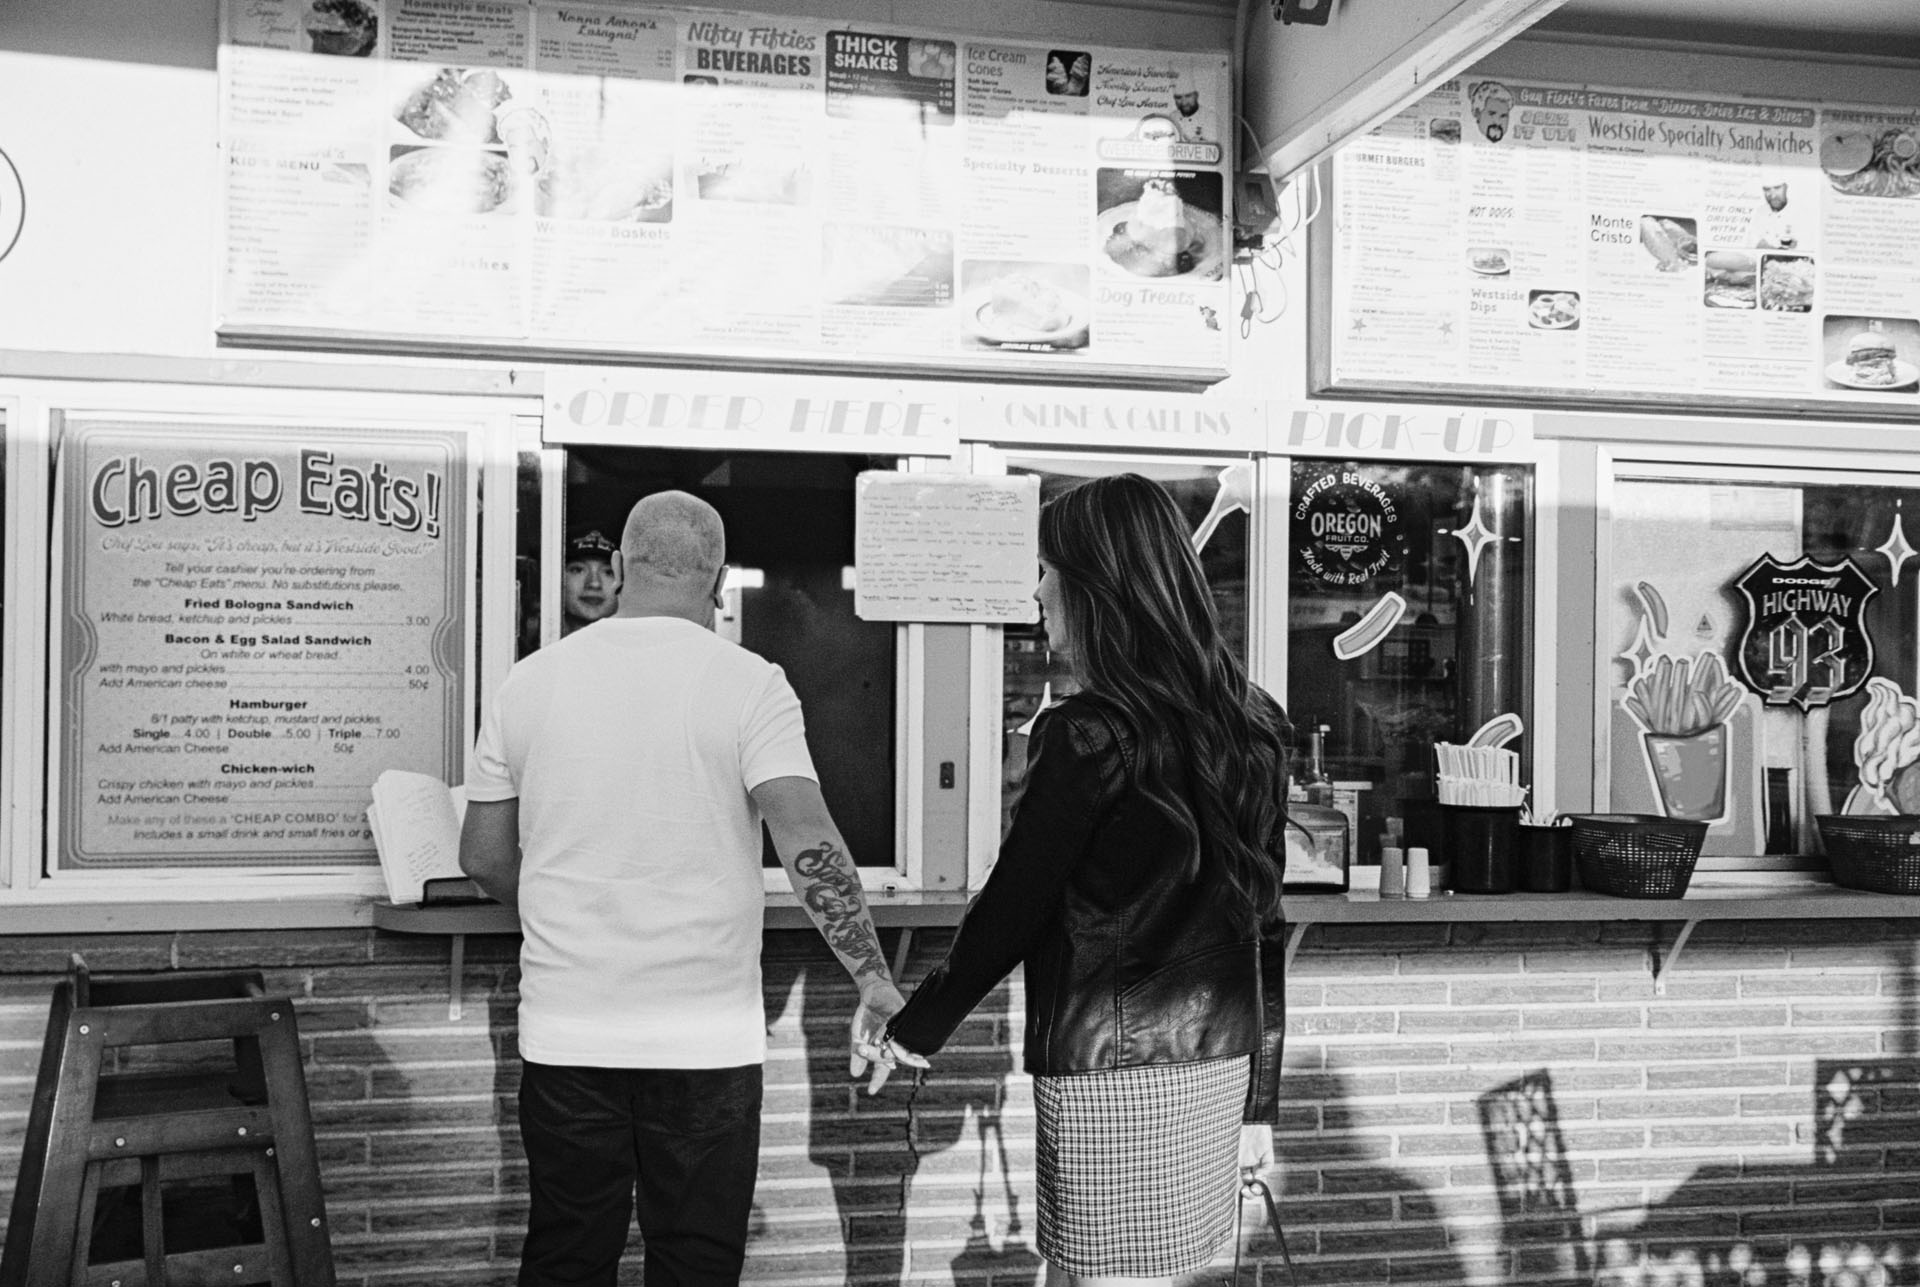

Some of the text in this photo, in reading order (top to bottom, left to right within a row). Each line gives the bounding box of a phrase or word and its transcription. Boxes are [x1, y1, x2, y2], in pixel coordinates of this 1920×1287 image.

[558, 10, 600, 25] Nonna
[688, 22, 816, 51] Nifty Fifties
[834, 35, 898, 57] THICK
[697, 48, 811, 77] BEVERAGES
[834, 53, 899, 72] SHAKES
[968, 47, 1027, 64] Ice Cream
[967, 62, 1003, 76] Cones
[1520, 89, 1542, 104] Guy
[1588, 115, 1655, 141] Westside
[1659, 121, 1723, 149] Specialty
[1729, 127, 1813, 154] Sandwiches
[1167, 145, 1201, 159] DRIVE
[1204, 146, 1217, 160] IN
[962, 157, 1088, 177] Specialty Desserts
[1467, 206, 1486, 218] HOT
[1705, 204, 1725, 213] THE
[1591, 213, 1634, 230] Monte
[611, 226, 671, 240] Baskets
[1590, 229, 1633, 245] Cristo
[1099, 288, 1196, 307] Dog Treats
[1470, 288, 1525, 301] Westside
[1470, 301, 1498, 314] Dips
[568, 389, 937, 437] ORDER HERE
[1004, 402, 1092, 429] ONLINE
[1126, 406, 1184, 433] CALL
[1194, 410, 1231, 436] INS
[1287, 410, 1515, 454] PICK-UP
[91, 447, 440, 538] Cheap Eats!
[1295, 472, 1397, 523] CRAFTED BEVERAGES
[1311, 512, 1382, 538] OREGON
[1325, 534, 1370, 543] FRUIT CO.
[165, 562, 376, 577] Tell your cashier you're ordering from
[1300, 546, 1391, 585] Made with Real Fruit
[132, 577, 151, 588] the
[155, 577, 197, 590] "Cheap
[272, 580, 289, 590] No
[291, 579, 361, 590] substitutions
[1772, 577, 1831, 585] DODGE
[184, 598, 354, 611] Fried Bologna Sandwich
[1763, 589, 1852, 617] HIGHWAY
[100, 612, 134, 623] White
[178, 613, 225, 625] ketchup
[228, 614, 250, 624] and
[252, 614, 292, 626] pickles
[405, 615, 430, 626] 3.00
[164, 633, 372, 647] Bacon & Egg Salad Sandwich
[201, 649, 303, 660] On white or wheat
[1767, 612, 1846, 704] 93
[99, 663, 430, 676] with mayo and pickles 4.00
[98, 677, 429, 690] Add American cheese 50¢
[229, 699, 308, 712] Hamburger
[170, 714, 198, 726] patty
[201, 714, 223, 724] with
[274, 714, 319, 724] mustard
[321, 714, 342, 724] and
[132, 728, 401, 741] Single 4.00 Double 5.00 Triple 7.00
[98, 742, 354, 754] Add American Cheese 50¢
[220, 763, 315, 774] Chicken-wich
[98, 778, 314, 791] Crispy chicken with mayo and pickles
[97, 793, 229, 805] Add American Cheese
[107, 813, 357, 827] Make any of these a for
[133, 828, 360, 840] Includes a small drink and small fries or
